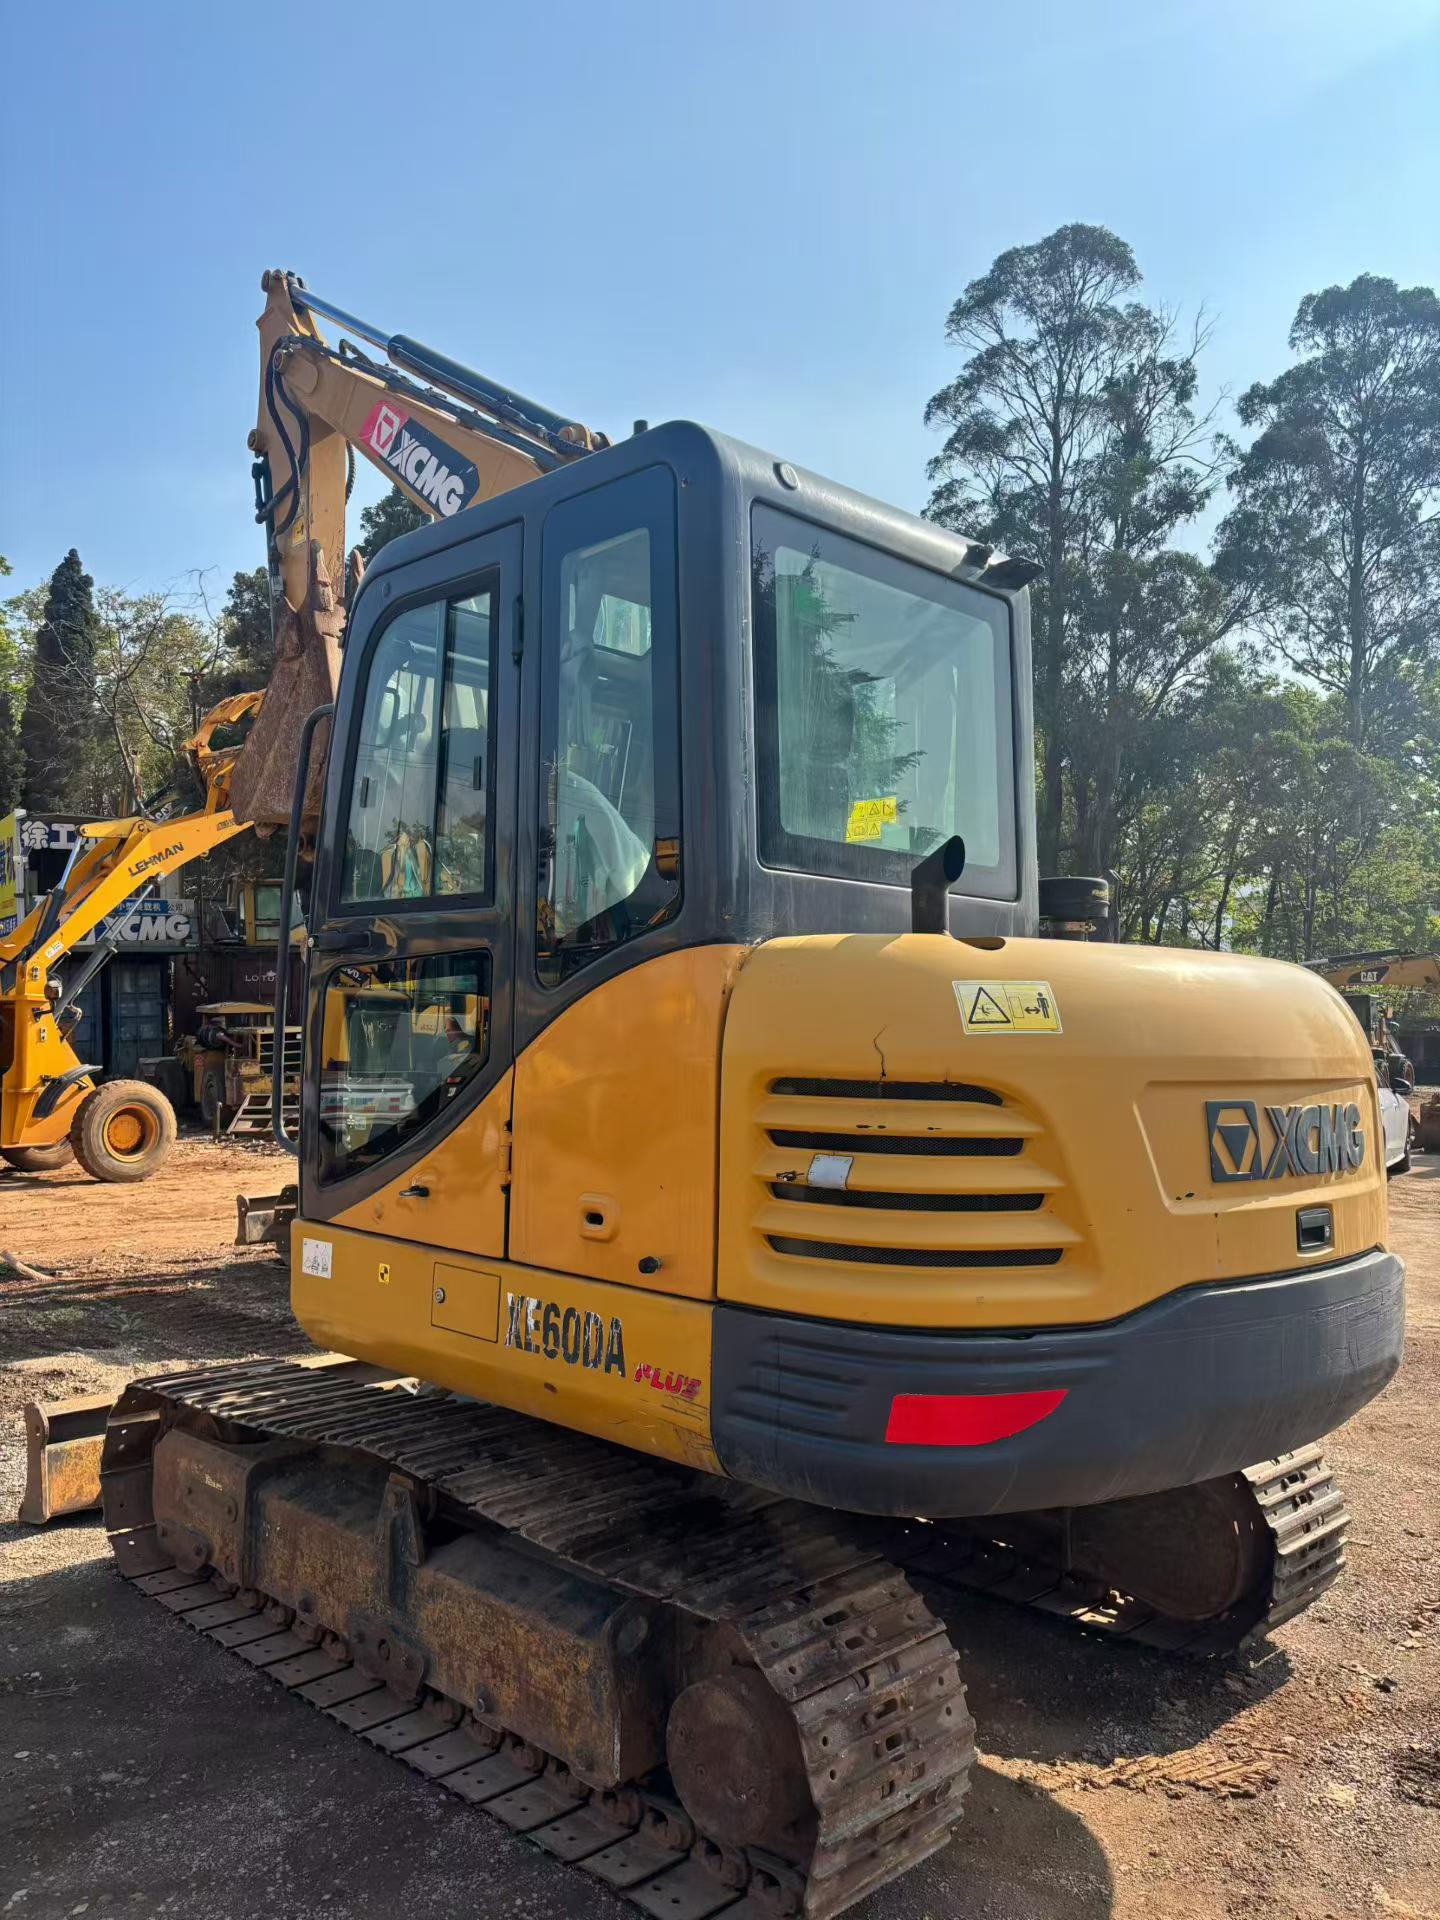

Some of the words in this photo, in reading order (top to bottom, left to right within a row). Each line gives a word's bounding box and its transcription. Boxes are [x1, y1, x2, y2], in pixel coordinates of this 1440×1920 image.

[387, 429, 464, 517] XCMG
[128, 842, 184, 876] LEHMAN
[97, 914, 190, 941] XCMG
[1360, 971, 1378, 982] CAT
[1264, 1102, 1364, 1179] XCMG
[505, 1292, 626, 1378] XE60DA
[634, 1362, 701, 1400] PLUS
